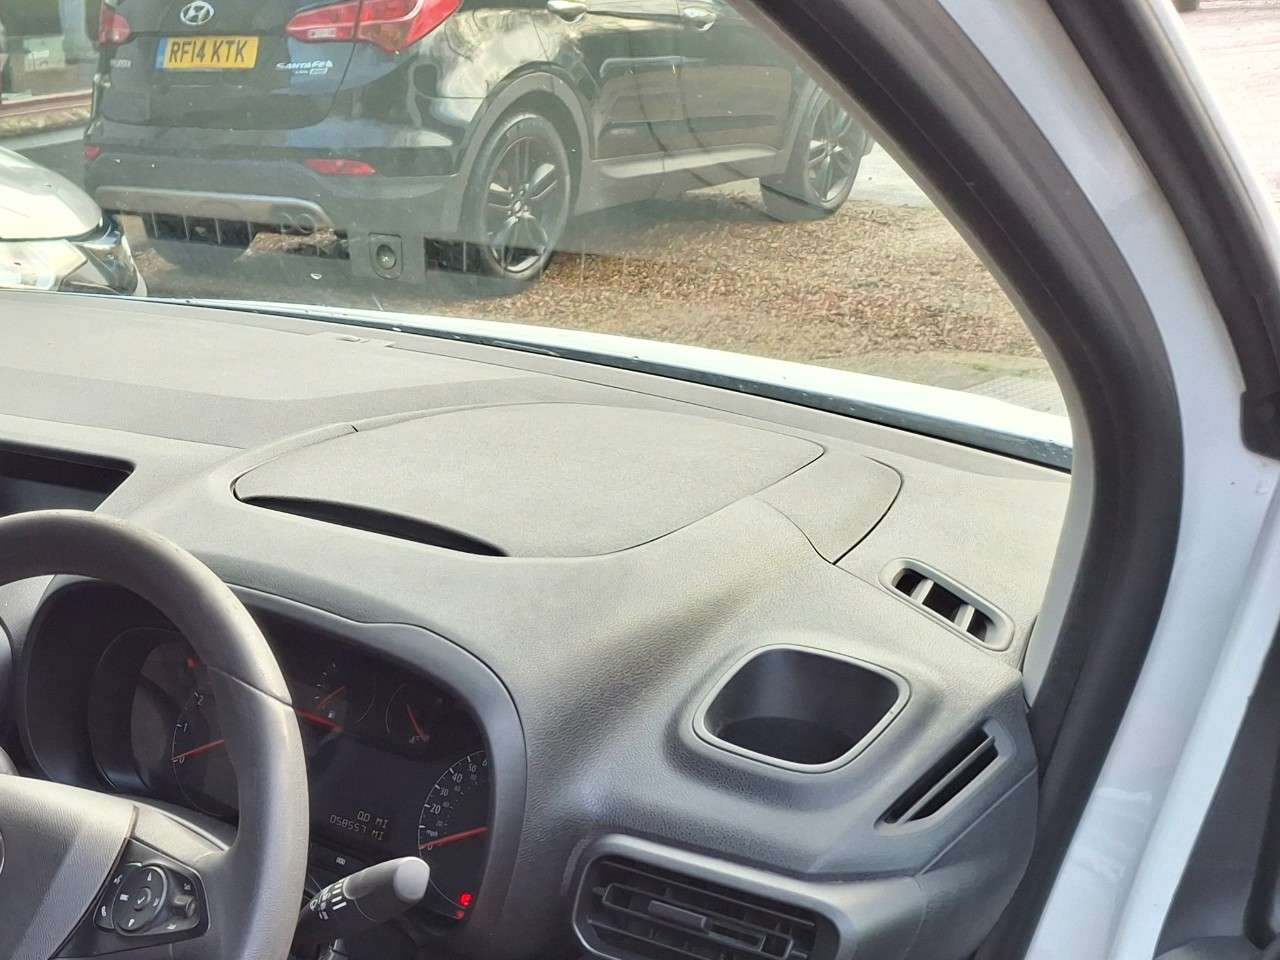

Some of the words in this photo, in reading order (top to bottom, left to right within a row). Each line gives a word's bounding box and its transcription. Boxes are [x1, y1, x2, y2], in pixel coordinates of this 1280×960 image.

[169, 40, 206, 63] RF14
[210, 39, 248, 63] KTK
[451, 773, 463, 783] 40
[429, 803, 441, 815] 20
